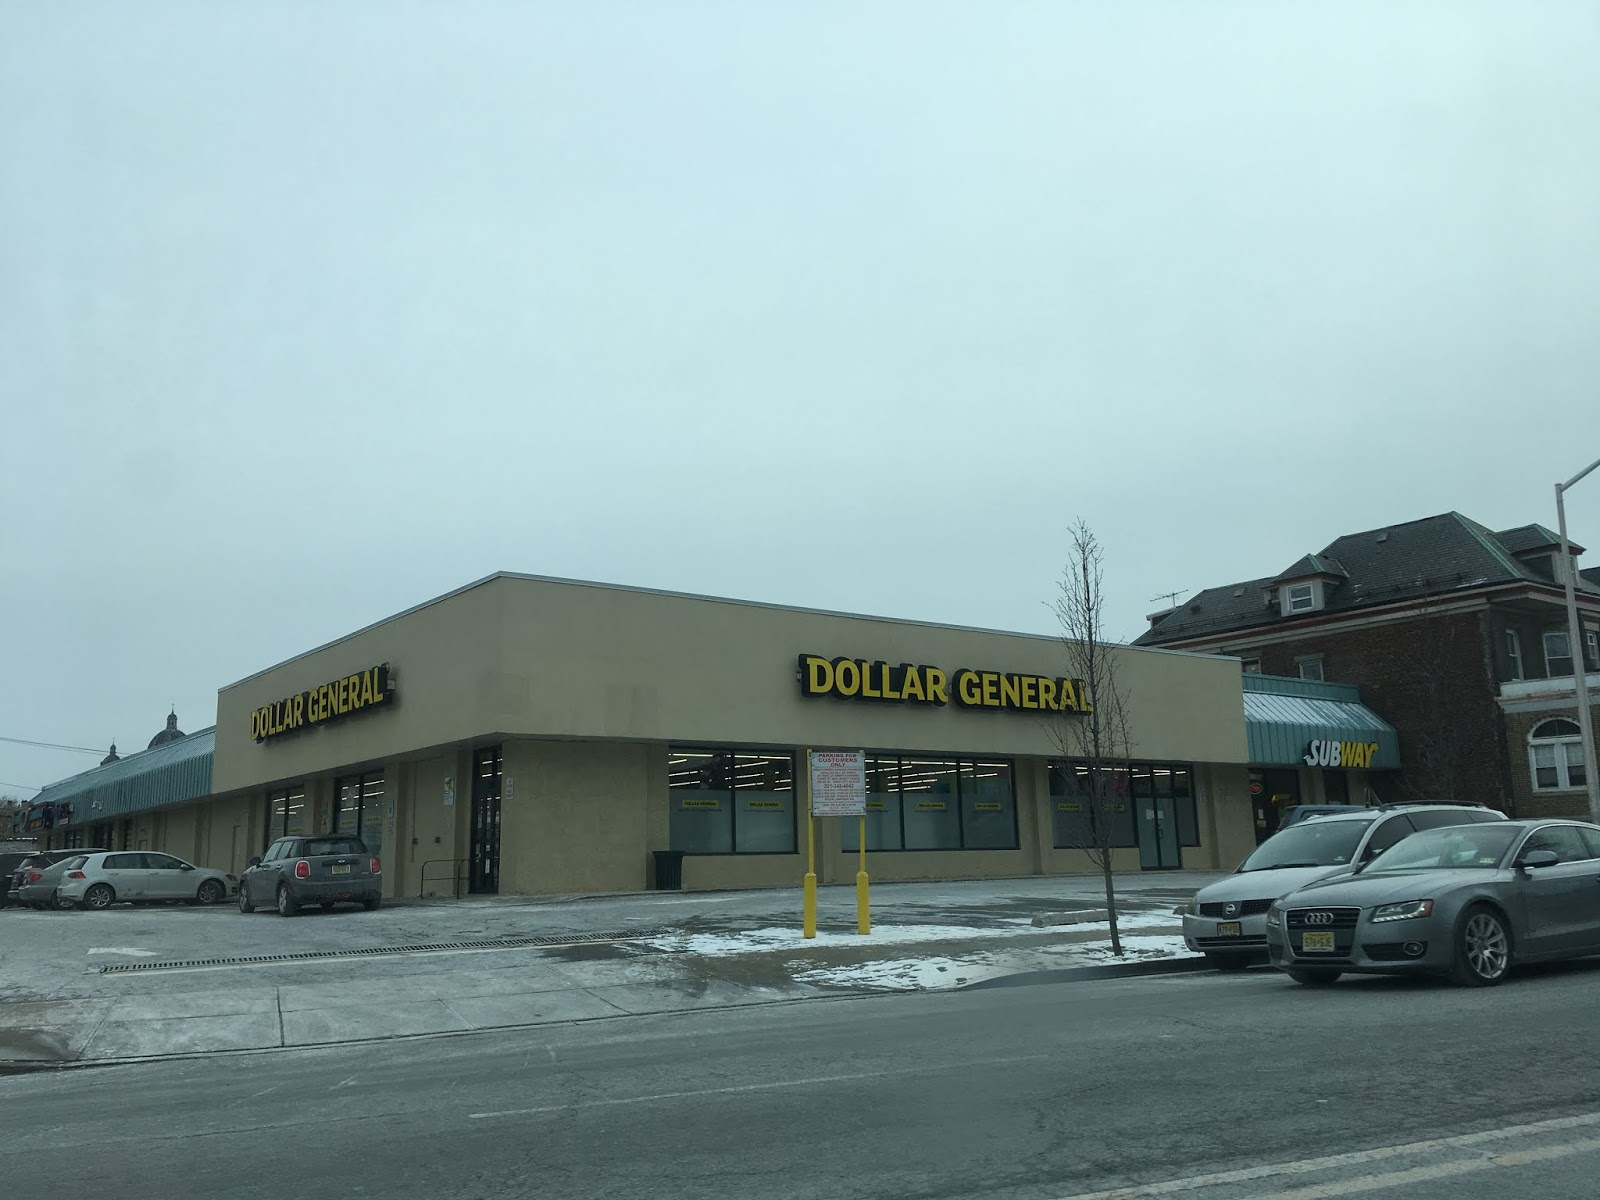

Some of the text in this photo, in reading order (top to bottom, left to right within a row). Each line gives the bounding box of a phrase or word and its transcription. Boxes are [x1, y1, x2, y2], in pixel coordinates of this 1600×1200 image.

[250, 666, 385, 741] DOLLAR GENERAL
[806, 656, 1094, 713] DOLLAR GENERAL
[1303, 739, 1379, 769] SUBWAY
